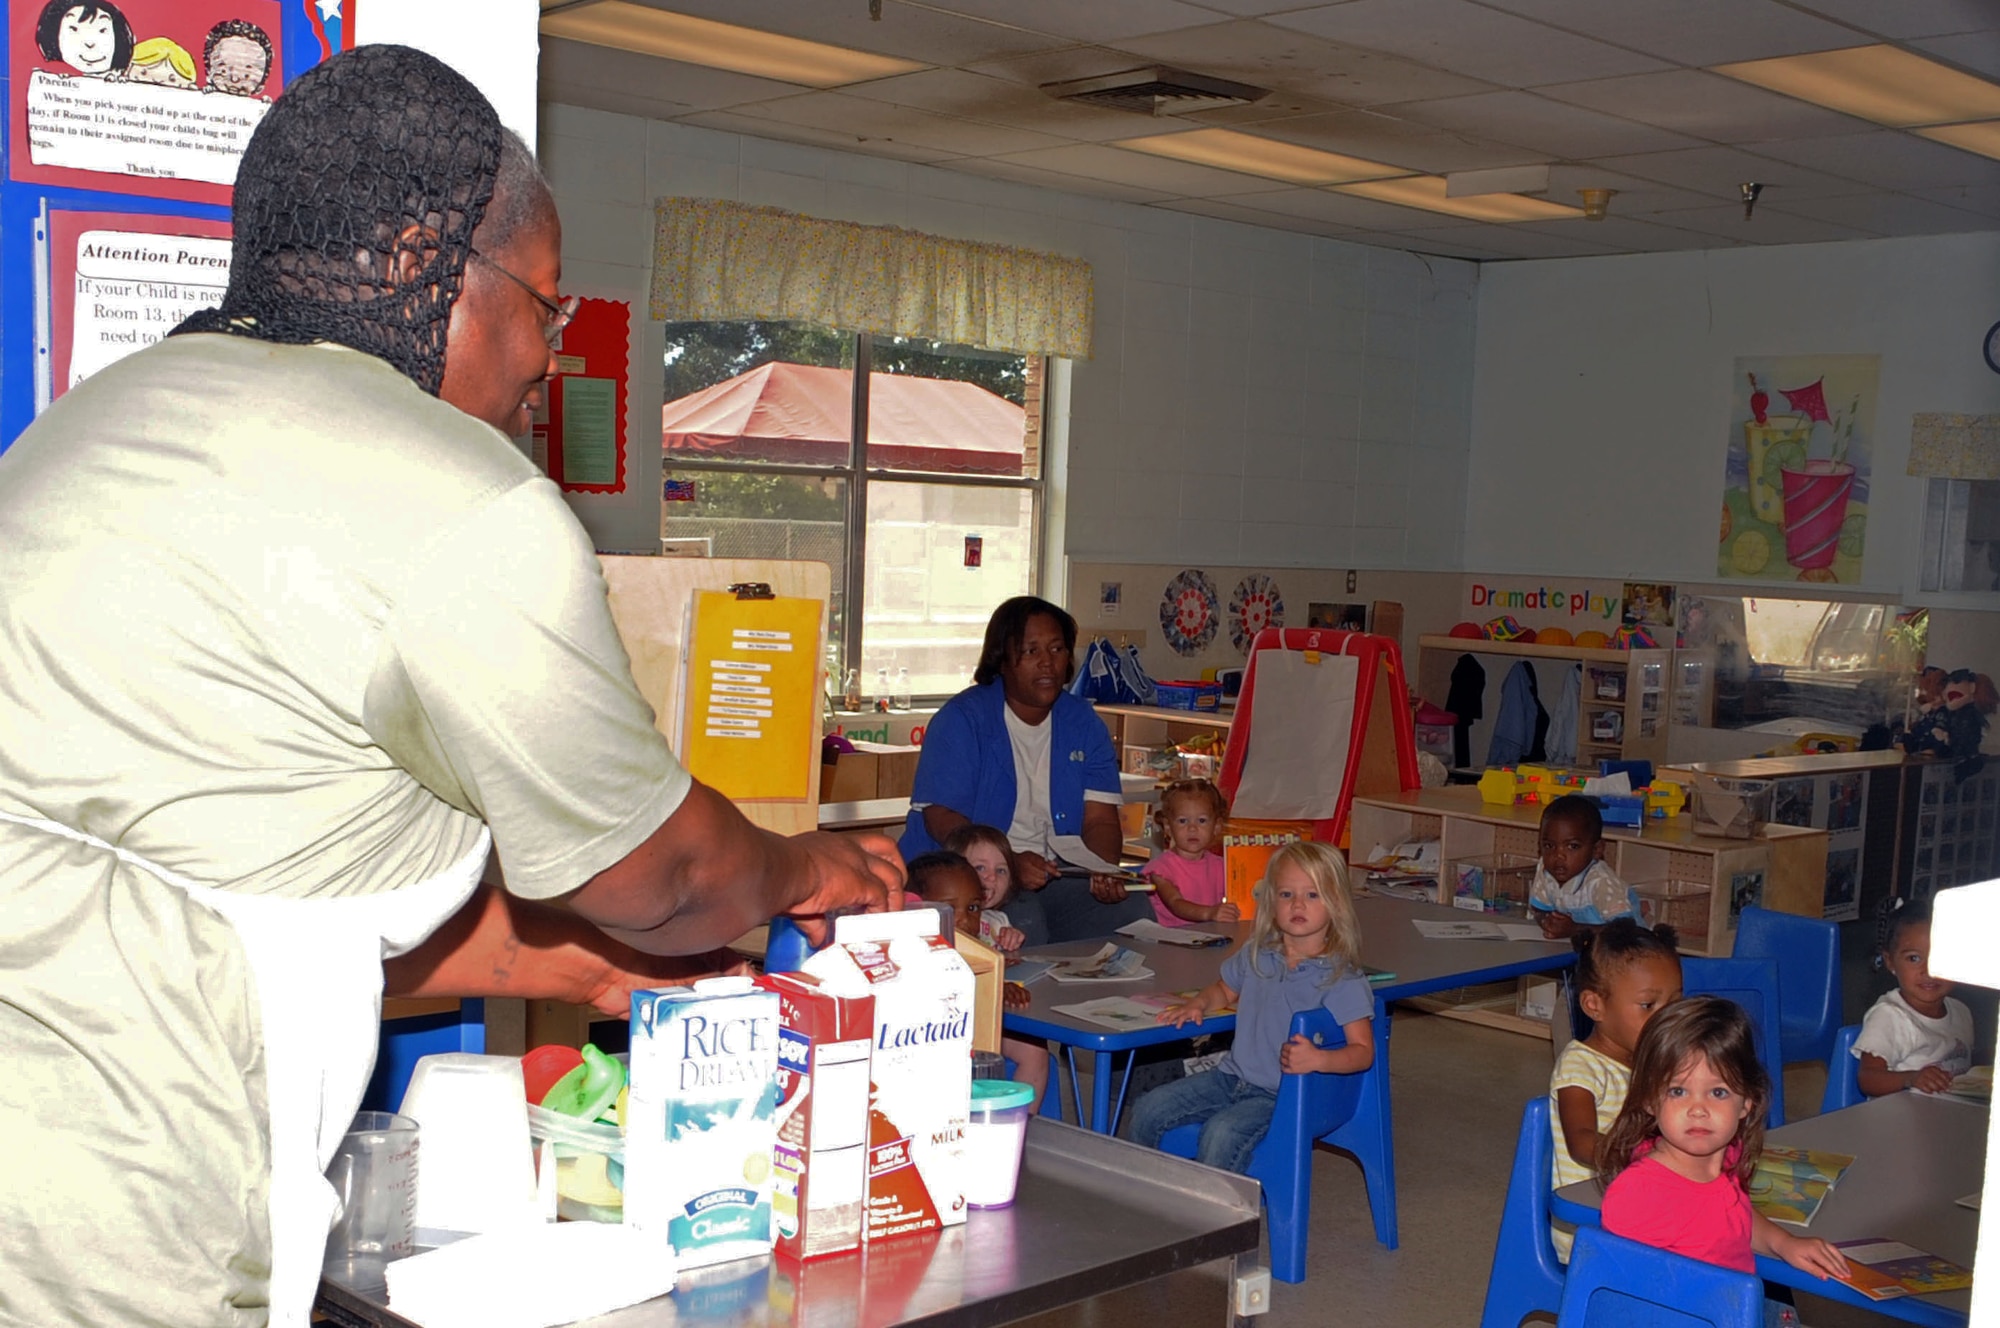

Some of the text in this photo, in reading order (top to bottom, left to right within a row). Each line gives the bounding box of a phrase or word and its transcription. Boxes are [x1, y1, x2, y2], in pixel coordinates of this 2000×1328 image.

[43, 91, 253, 127] When you pick your child up at the end of the
[28, 124, 65, 134] remain
[68, 126, 77, 135] in
[80, 128, 103, 138] their
[105, 132, 146, 144] assigned
[149, 138, 173, 147] room
[175, 140, 192, 148] due
[195, 142, 204, 150] to
[63, 110, 91, 121] Room
[94, 113, 105, 123] 13
[108, 115, 116, 124] is
[117, 117, 147, 129] closed
[149, 122, 170, 131] your
[221, 130, 237, 139] will
[125, 162, 175, 178] Thank you
[82, 243, 229, 268] Attention Paren
[78, 279, 92, 294] If
[94, 284, 132, 298] your
[136, 283, 178, 300] Child
[183, 286, 195, 300] is
[94, 303, 138, 321] Room
[100, 329, 137, 344] need
[142, 332, 158, 344] to
[1471, 584, 1618, 619] Dramatic play
[681, 1015, 770, 1060] RICE
[878, 1011, 969, 1050] Lactaid
[931, 1127, 965, 1147] MILK
